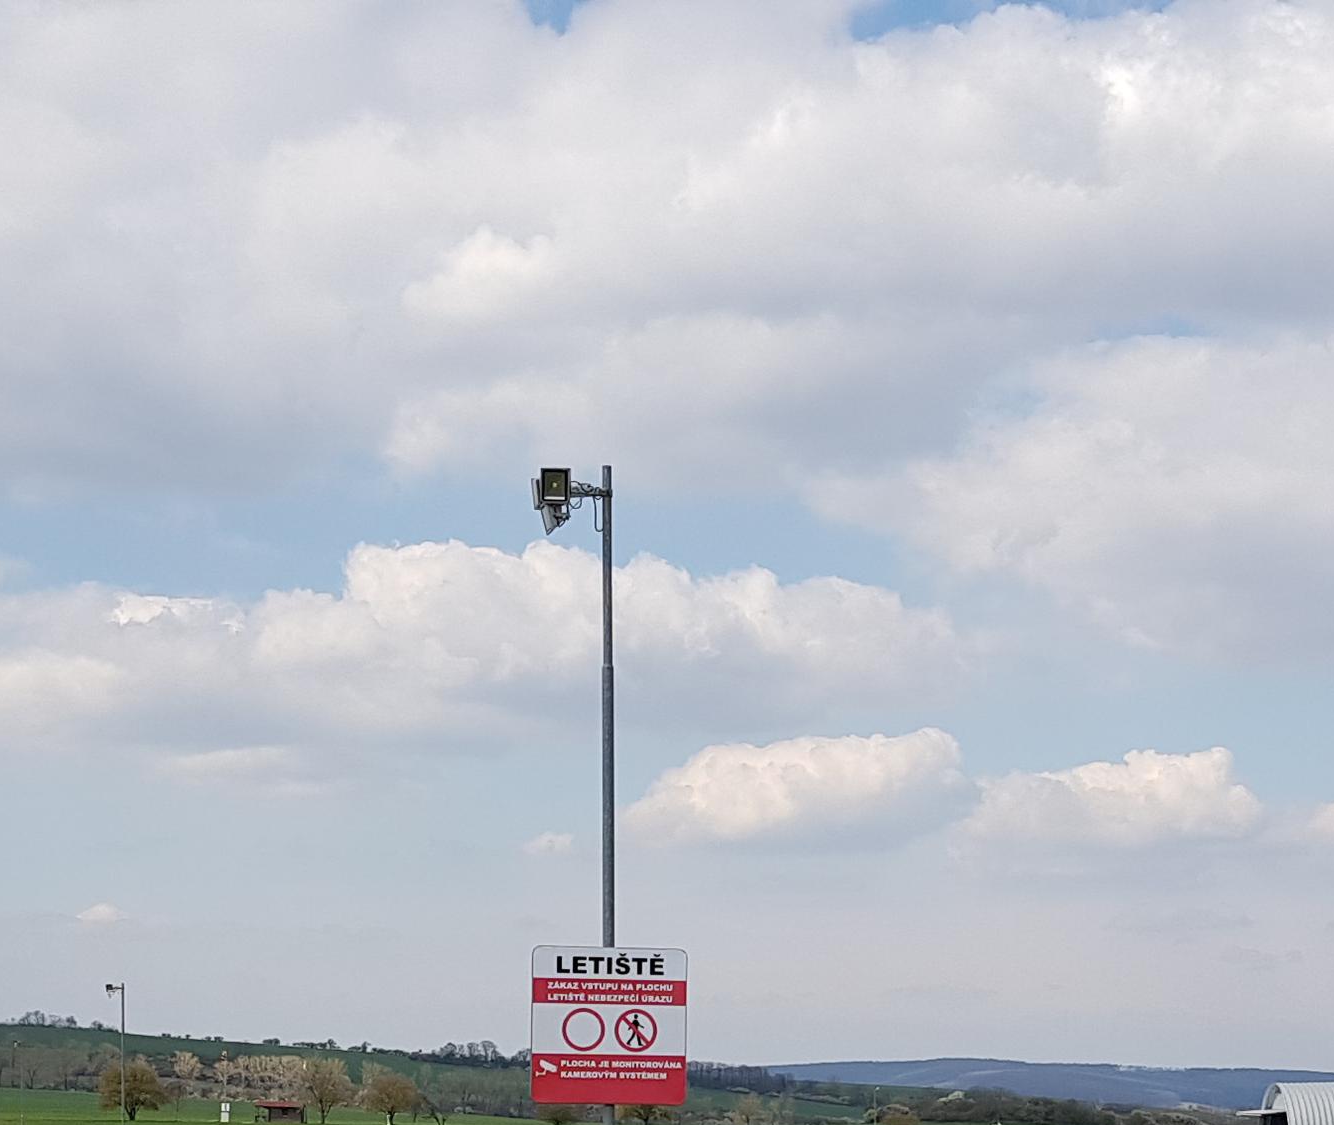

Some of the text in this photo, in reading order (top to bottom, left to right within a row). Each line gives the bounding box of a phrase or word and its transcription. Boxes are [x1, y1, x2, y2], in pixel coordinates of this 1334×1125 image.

[556, 953, 665, 976] LETIŠTĚ
[547, 981, 673, 992] ZÁKAZ VSTUPU NA PLOCHU
[547, 992, 586, 1001] LETIŠTĚ
[587, 993, 639, 1003] NEBEZPEČÍ
[560, 1060, 682, 1069] PLOCHA JE MONITOROVÁNA
[560, 1070, 617, 1079] KAMEROVÝM
